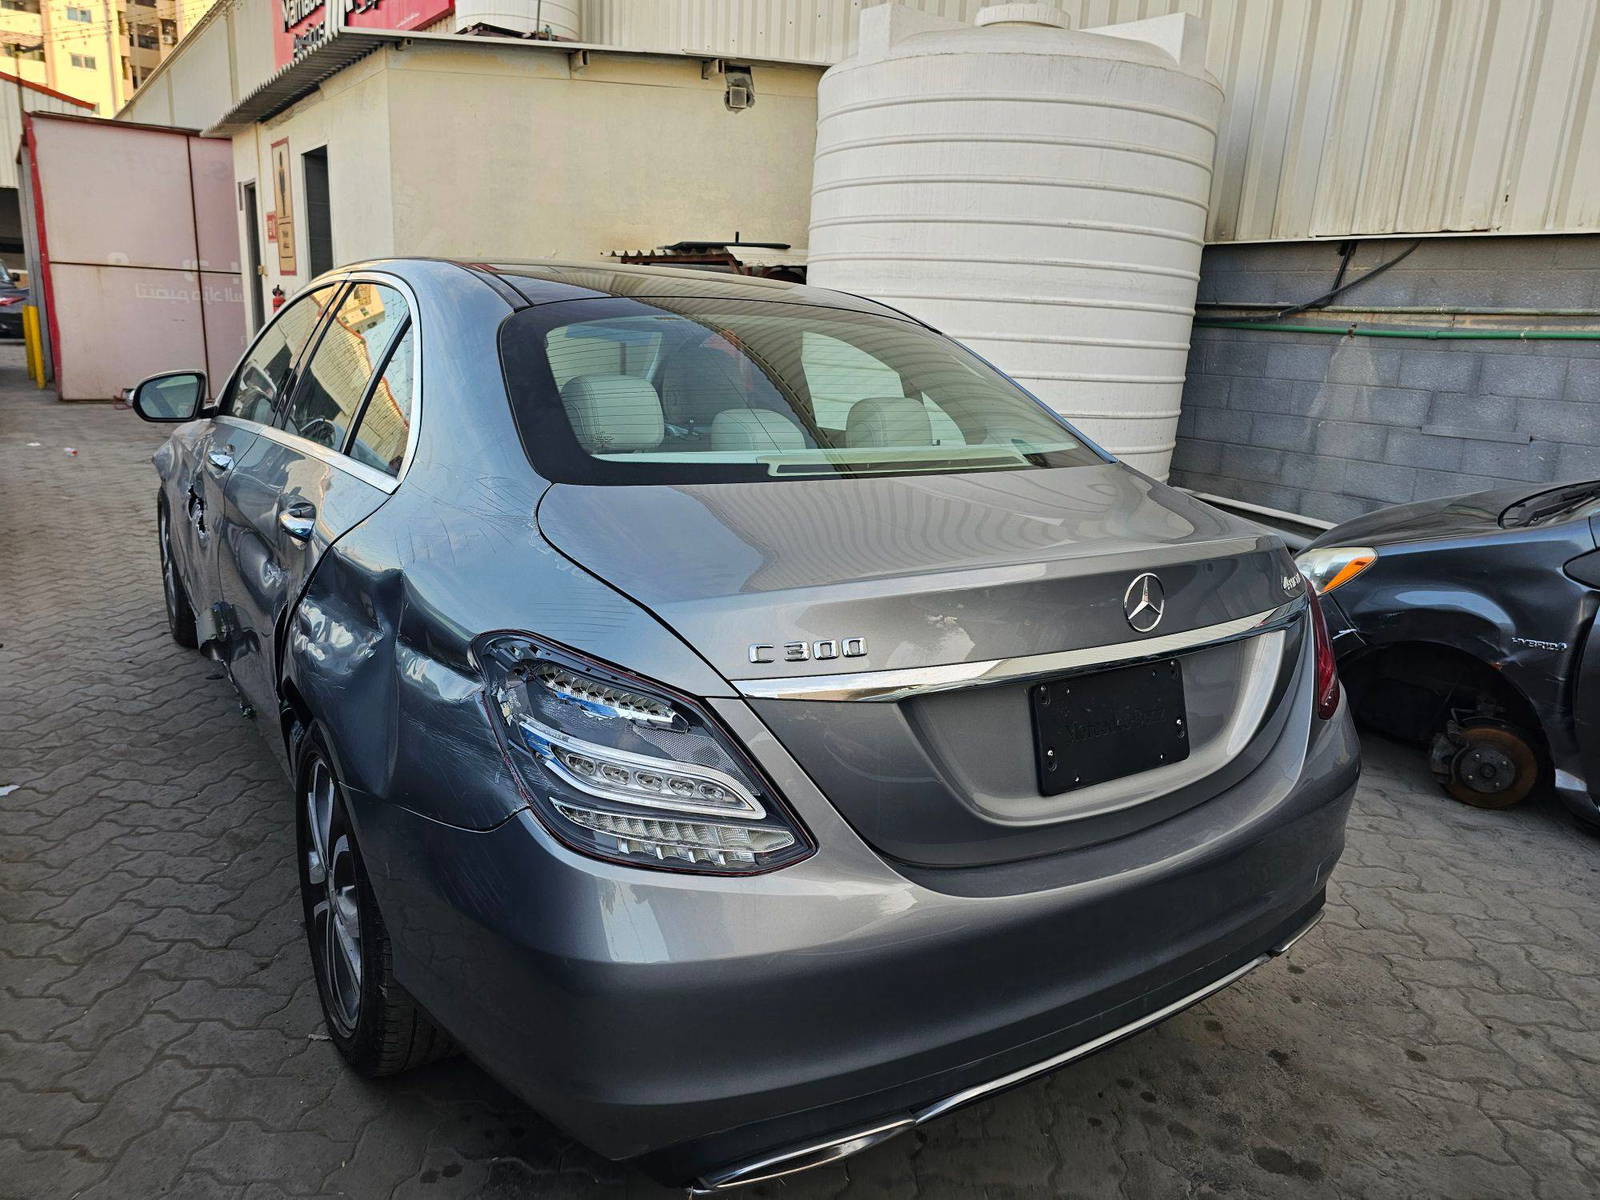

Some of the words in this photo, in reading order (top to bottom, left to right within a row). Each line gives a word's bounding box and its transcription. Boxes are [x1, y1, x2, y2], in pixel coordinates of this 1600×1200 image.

[748, 642, 775, 663] C
[783, 637, 868, 661] 300
[1511, 637, 1559, 650] HYBRID
